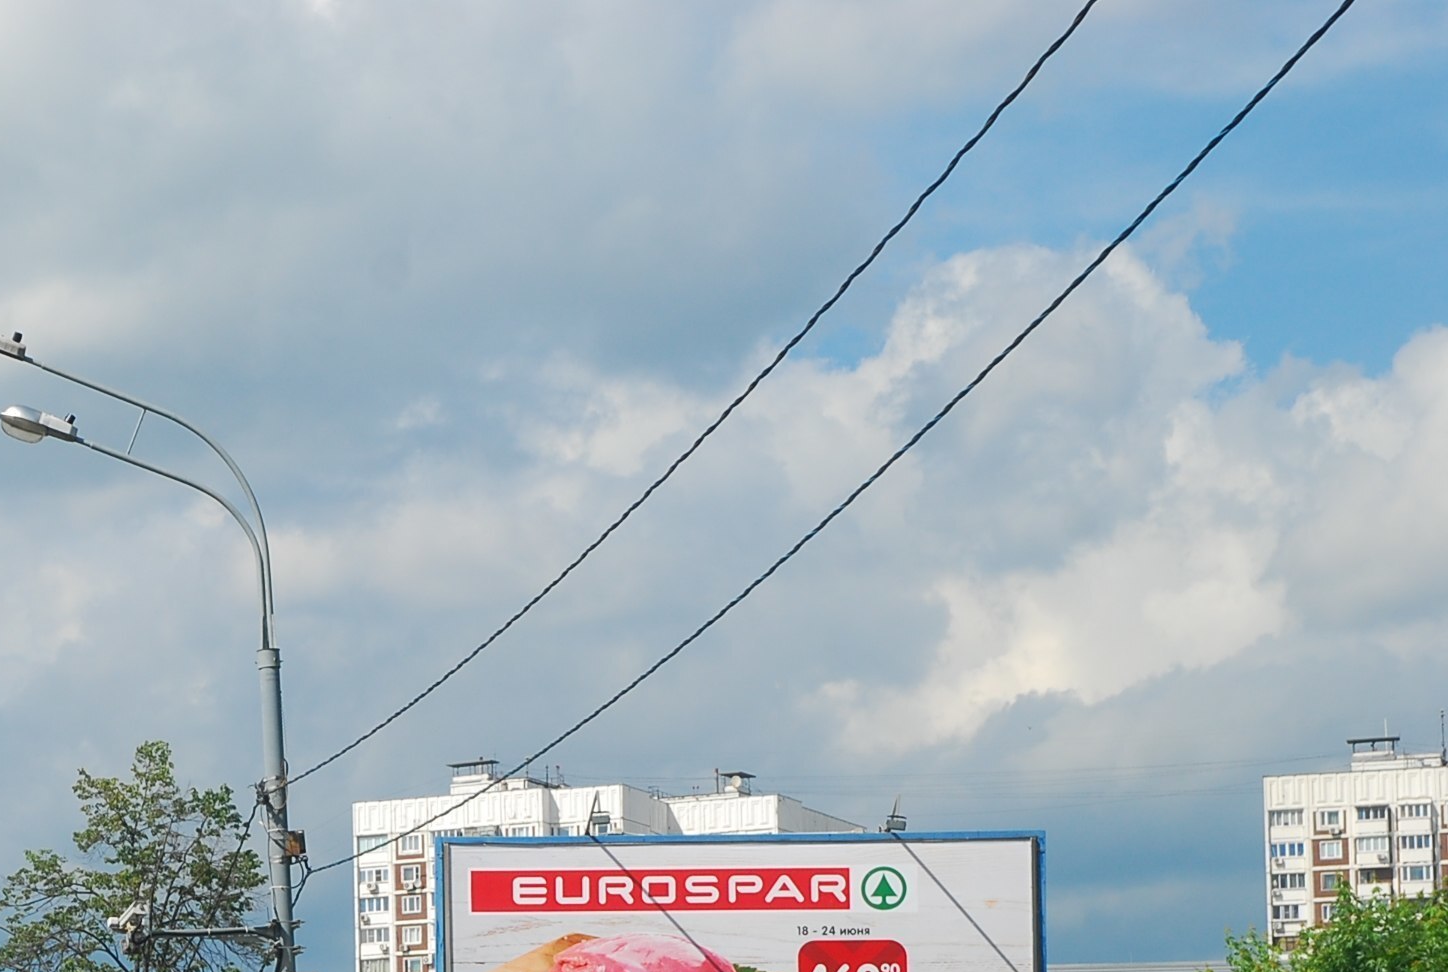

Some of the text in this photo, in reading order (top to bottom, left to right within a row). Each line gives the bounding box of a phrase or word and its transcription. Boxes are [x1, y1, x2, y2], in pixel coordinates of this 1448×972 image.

[512, 874, 847, 906] EUROSPAR
[797, 925, 809, 936] 18
[821, 925, 836, 936] 24
[839, 927, 870, 936] июня
